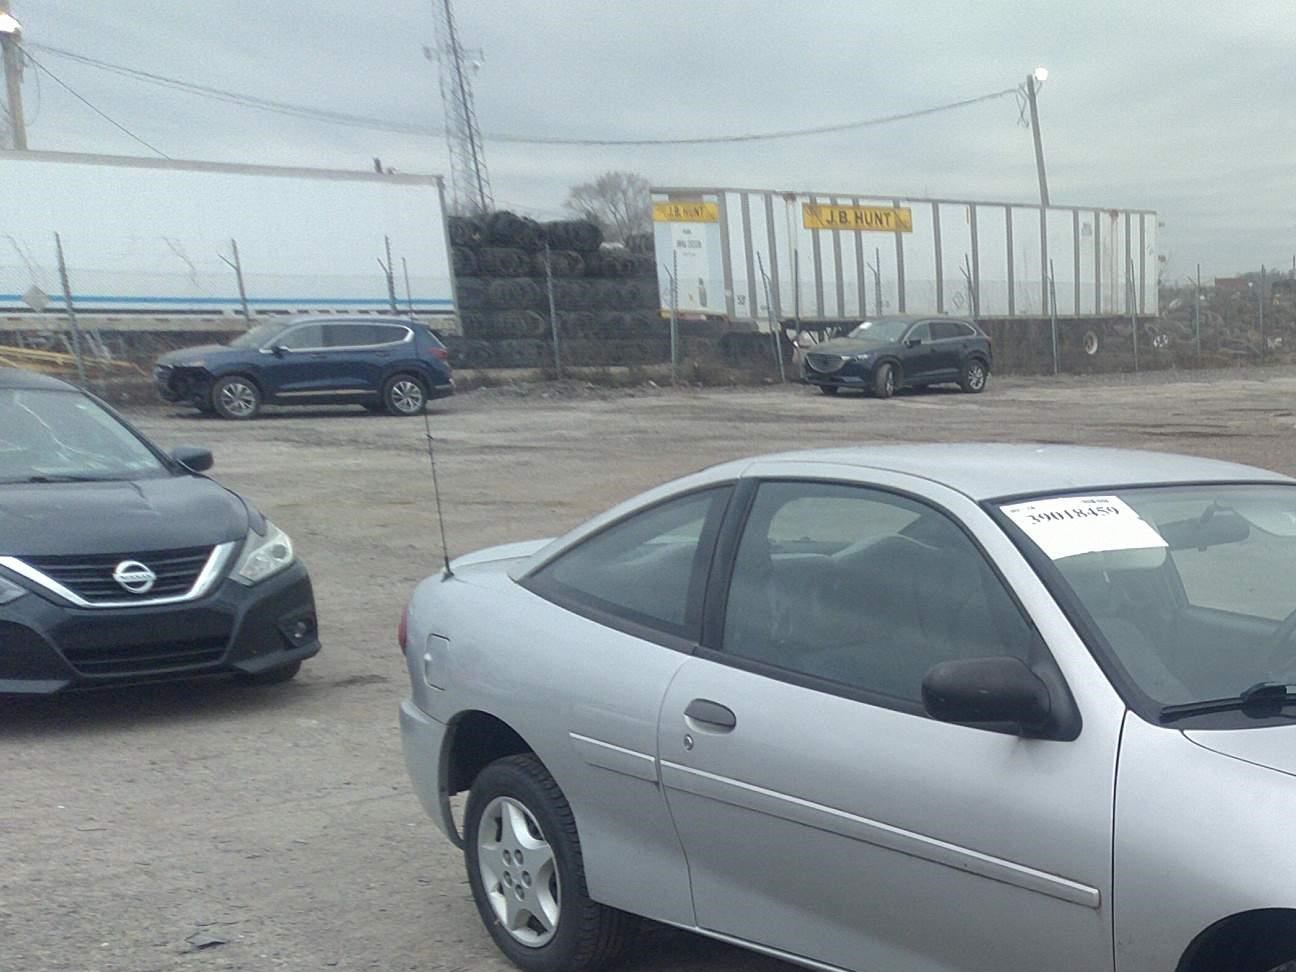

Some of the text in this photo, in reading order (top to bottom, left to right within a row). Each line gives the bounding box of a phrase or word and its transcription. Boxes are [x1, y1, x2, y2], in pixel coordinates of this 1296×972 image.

[826, 210, 891, 227] J.B. HUNT
[1024, 506, 1120, 525] 39018459
